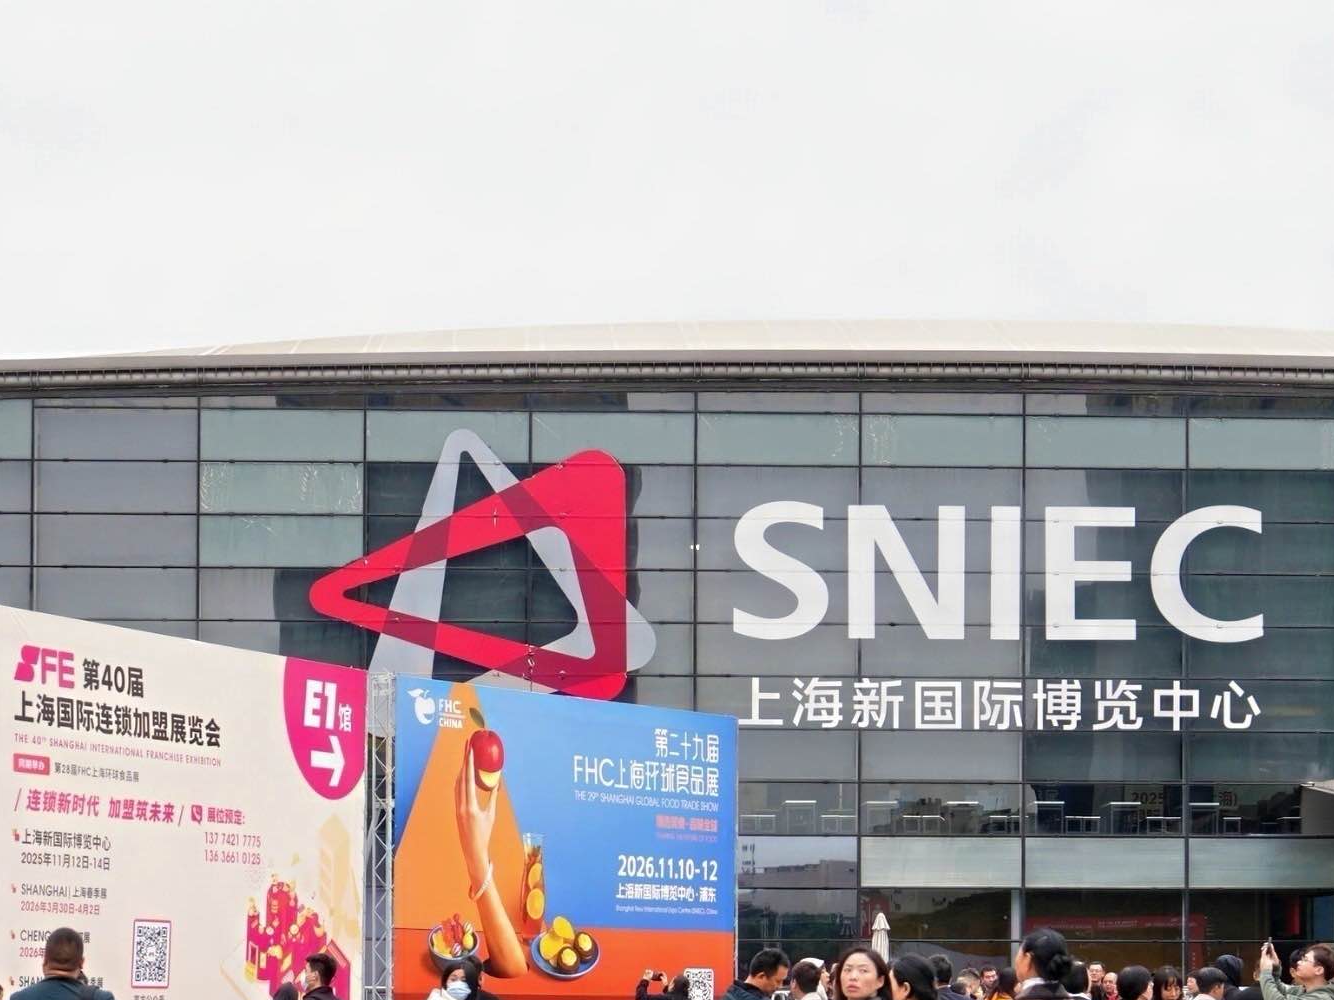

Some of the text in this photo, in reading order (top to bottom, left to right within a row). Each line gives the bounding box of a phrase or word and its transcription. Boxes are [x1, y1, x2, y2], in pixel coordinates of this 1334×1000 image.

[733, 500, 1264, 643] SNIEC
[82, 658, 144, 699] 第40届
[303, 679, 353, 733] E1馆
[438, 699, 462, 714] FHC
[738, 676, 1262, 731] 上海新国际博览中心
[14, 691, 221, 748] 上海国际连锁加盟展览会
[439, 717, 463, 729] CHINA
[14, 733, 221, 768] THE SHANGHAI INTERNATIONAL FRANCHISE EXHIBITION
[654, 728, 719, 763] 第二十九届
[573, 755, 719, 797] FHC上海环球食品展
[27, 789, 175, 823] 连锁新时代 加盟筑未来
[600, 793, 634, 806] SHANGHAI
[636, 796, 659, 808] GLOBAL
[661, 798, 680, 809] FOOD
[681, 800, 700, 812] TRADE
[701, 802, 719, 813] SHOW
[21, 828, 112, 852] 上海新国际博览中心
[204, 831, 261, 848] 137 7421 7775
[20, 852, 110, 871] 2025年11月12日-14日
[204, 849, 261, 865] 136 3661 0125
[617, 854, 718, 881] 2026.11.10-12
[21, 883, 68, 898] SHANGHAI
[20, 901, 100, 915] 2026年3月30日-4月2日
[20, 930, 51, 942] CHENG
